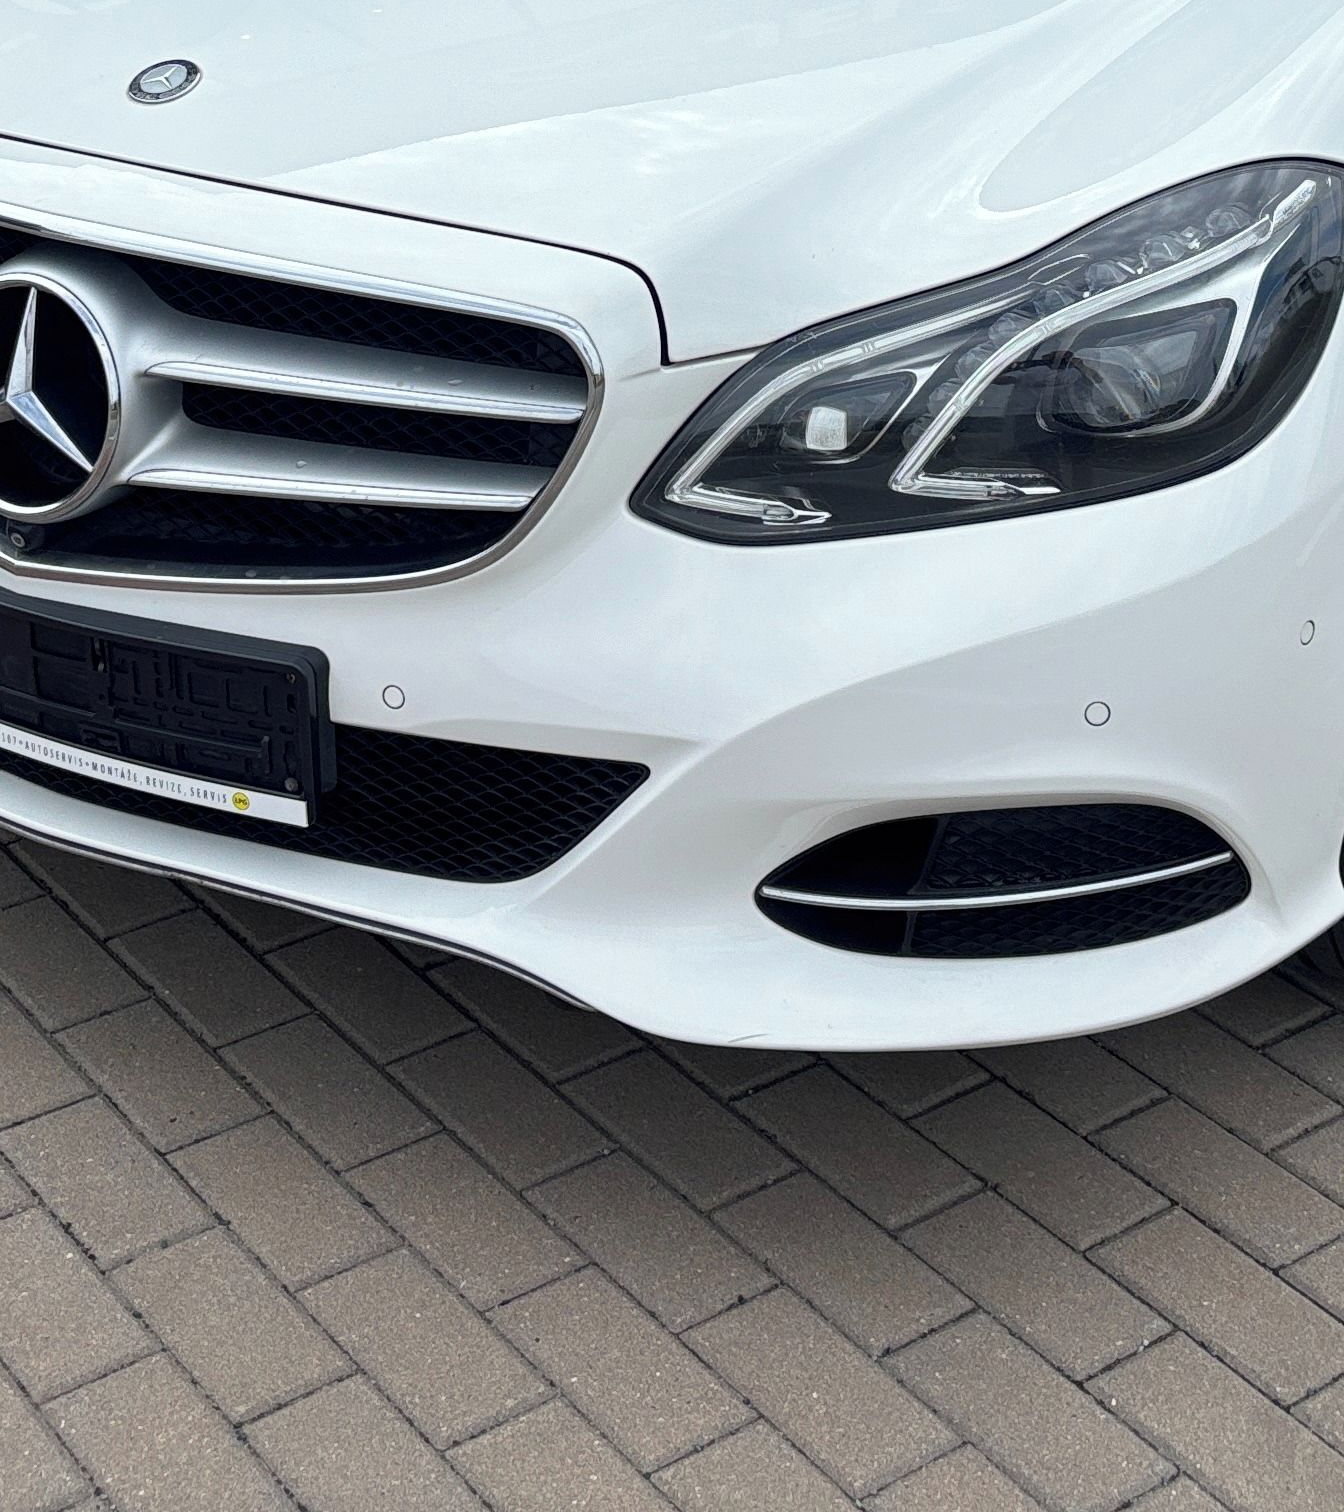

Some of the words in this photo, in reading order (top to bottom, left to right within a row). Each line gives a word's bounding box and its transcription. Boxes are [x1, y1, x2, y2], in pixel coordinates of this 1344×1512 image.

[1, 731, 17, 745] 107
[24, 741, 84, 768] AUTOSERVIS
[190, 786, 228, 804] SERVIS
